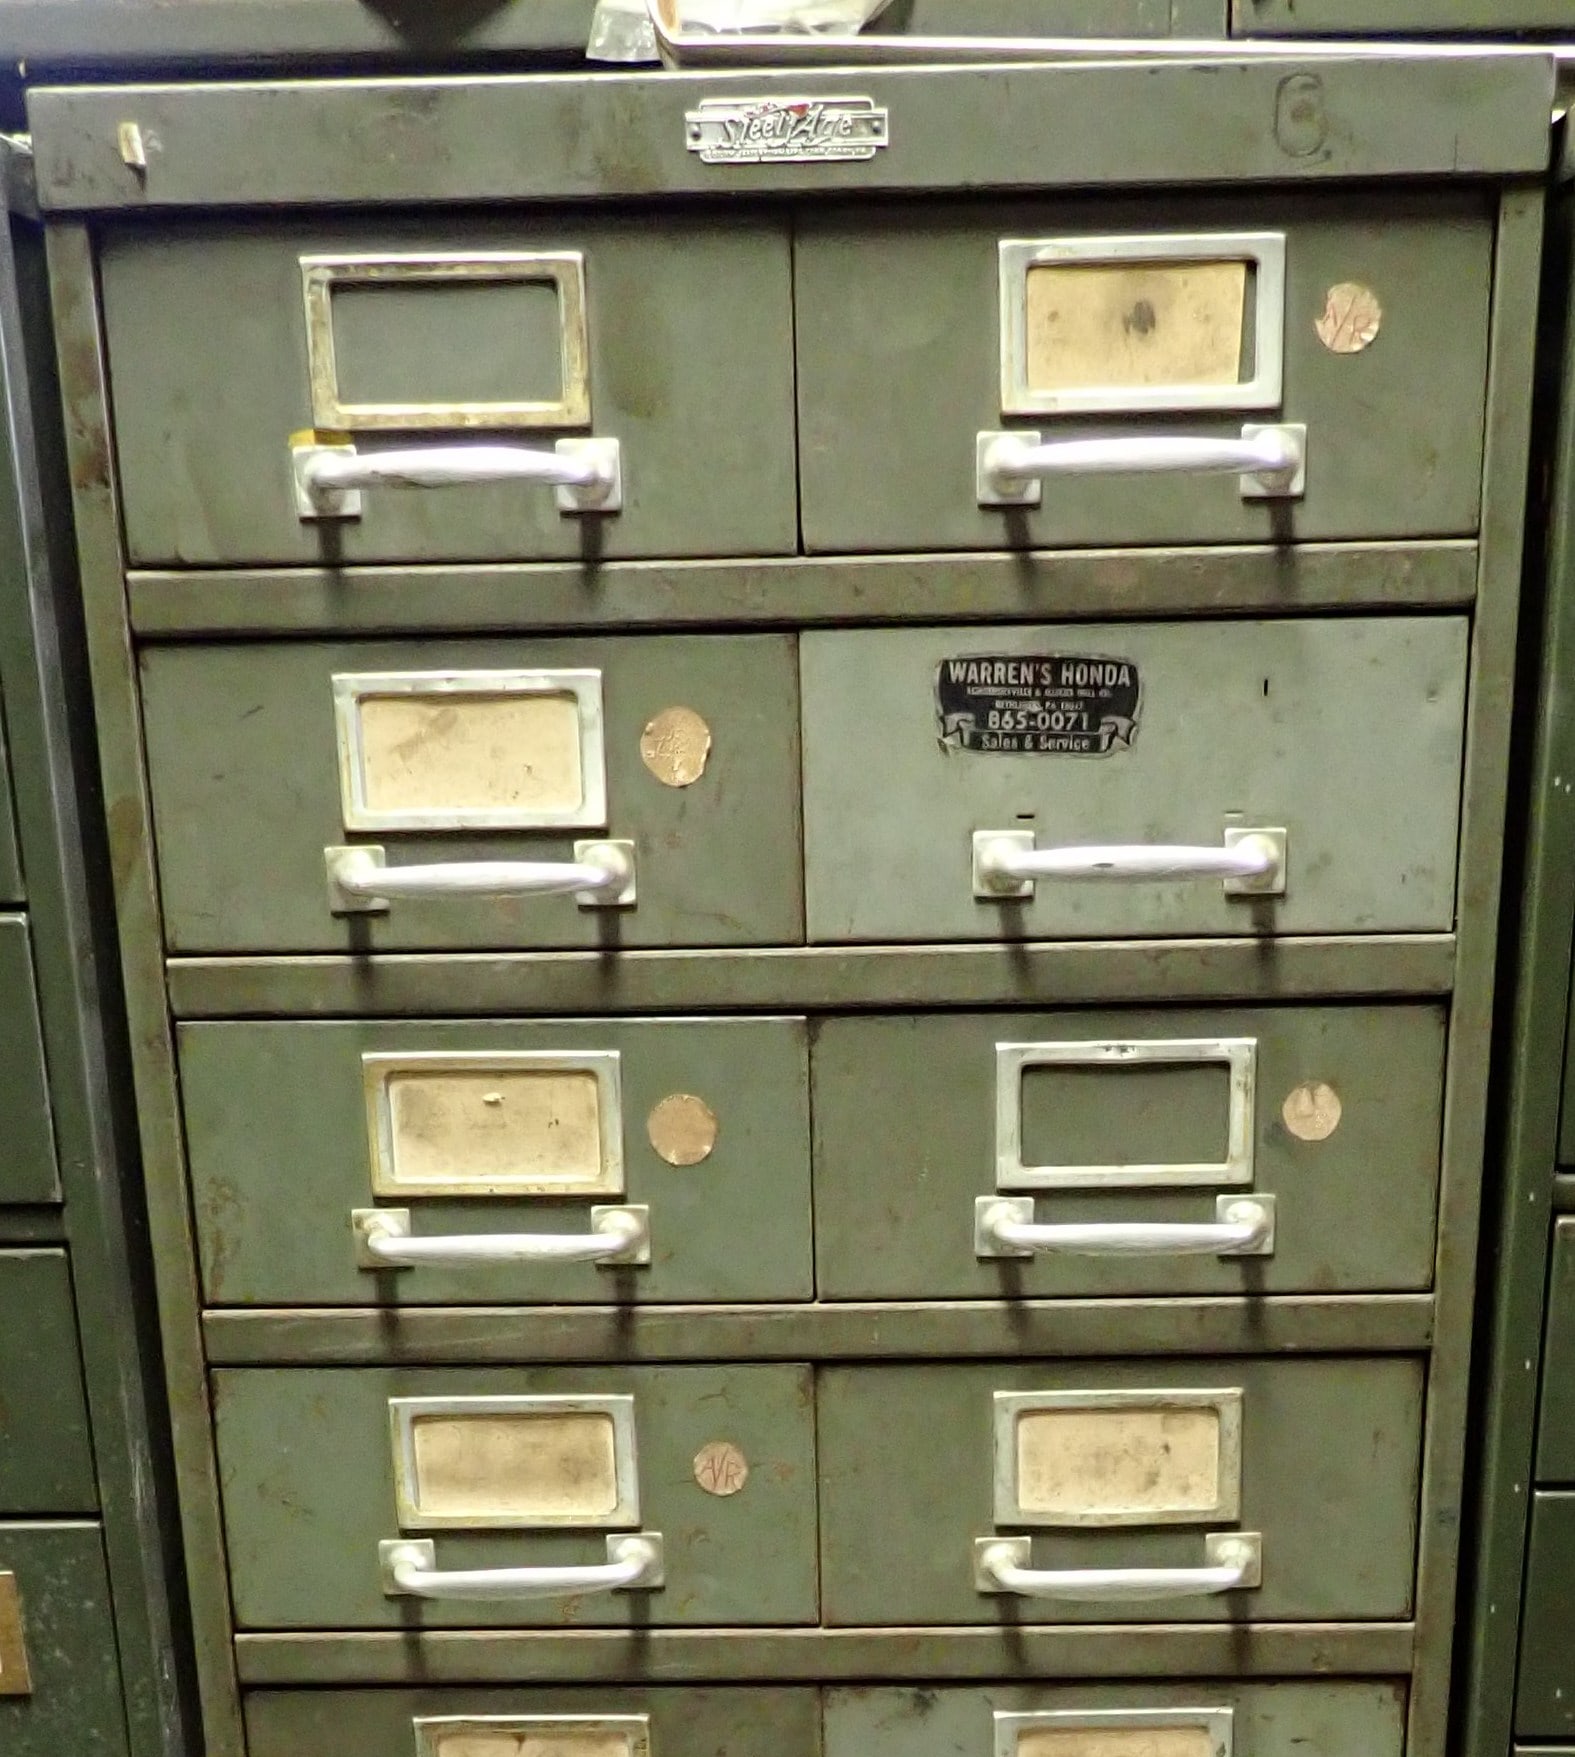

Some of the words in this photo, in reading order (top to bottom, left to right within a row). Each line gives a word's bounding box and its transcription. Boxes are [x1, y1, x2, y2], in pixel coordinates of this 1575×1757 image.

[949, 661, 1051, 686] WARREN'S
[1061, 664, 1131, 687] HONDA
[987, 710, 1089, 730] 865-0071
[981, 733, 1018, 750] Sales
[1024, 735, 1034, 750] &
[1039, 733, 1091, 750] Service
